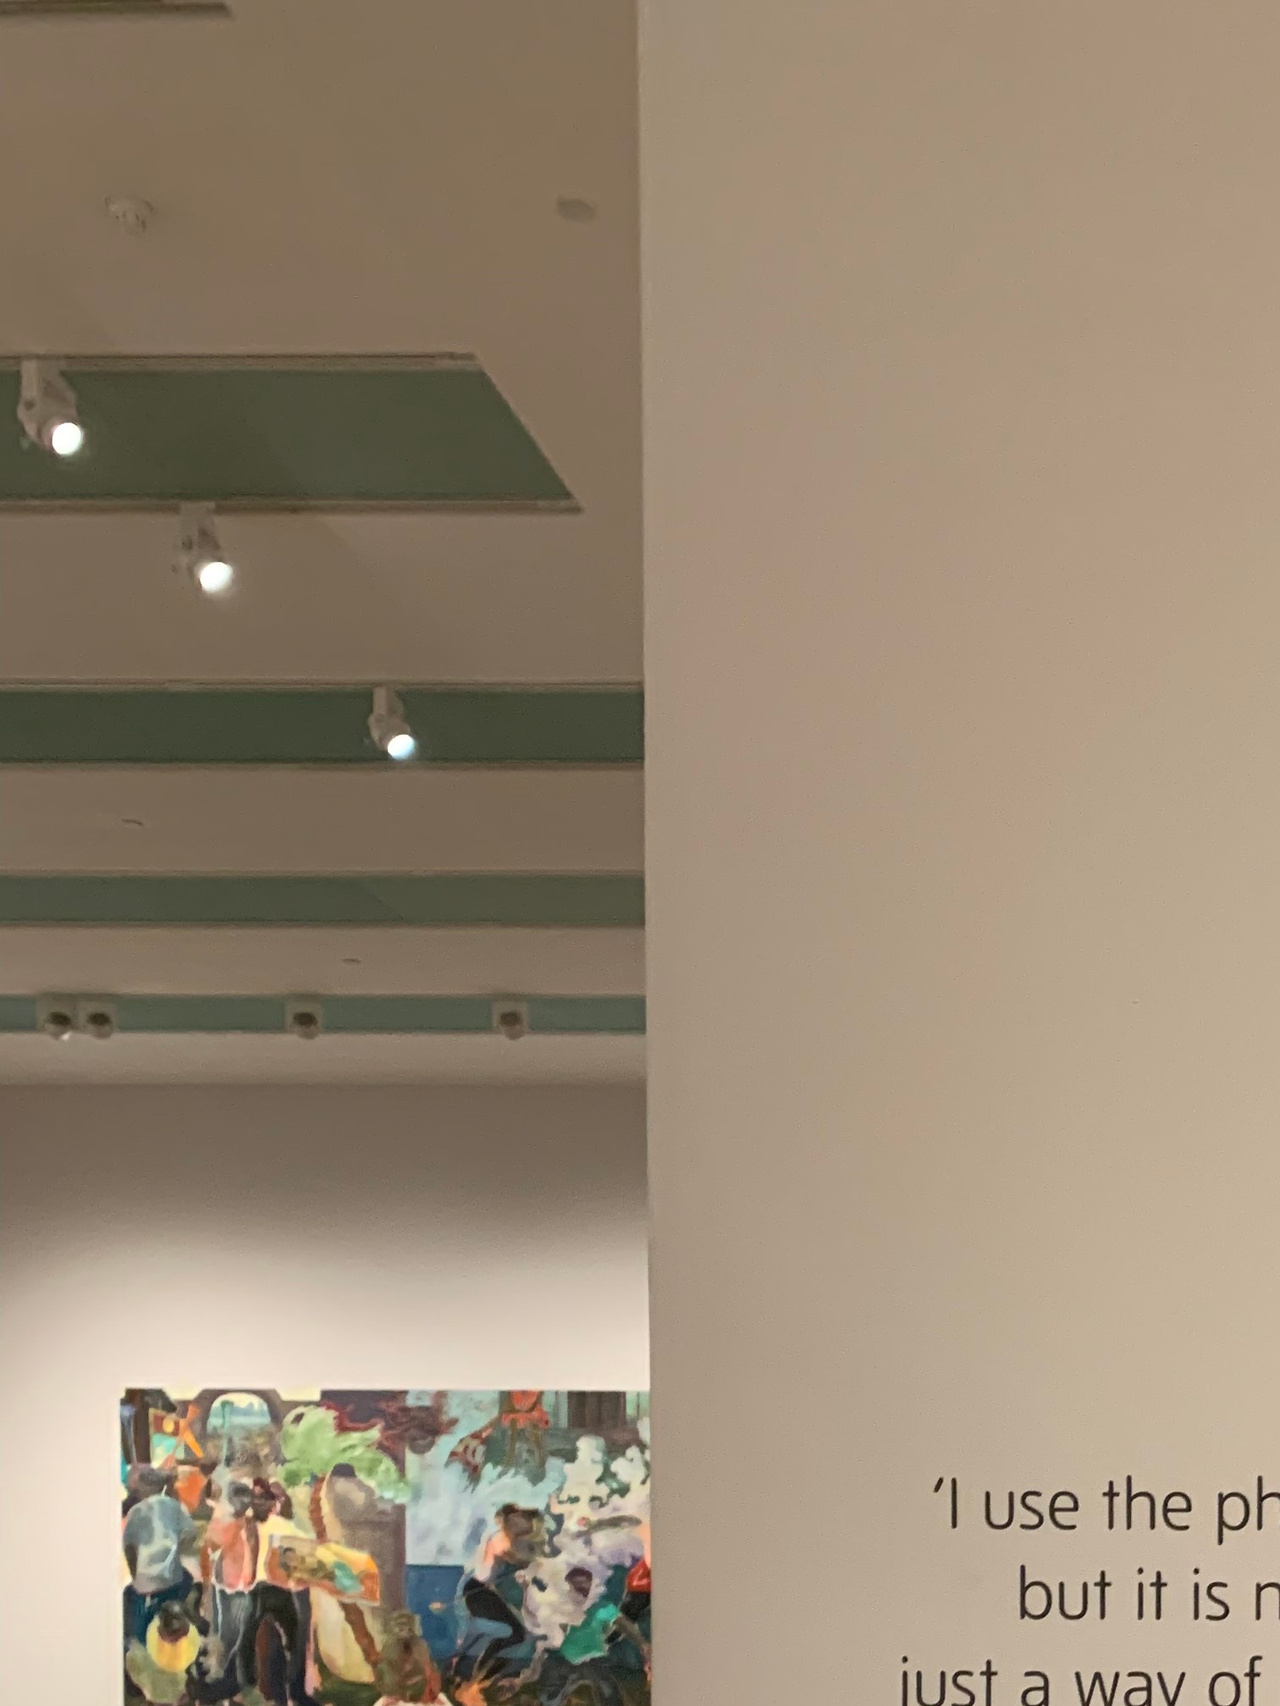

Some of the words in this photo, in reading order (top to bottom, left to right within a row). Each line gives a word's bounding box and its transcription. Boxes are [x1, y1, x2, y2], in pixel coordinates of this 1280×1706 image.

[984, 1489, 1080, 1531] use
[1101, 1474, 1193, 1532] the
[1019, 1563, 1113, 1621] but
[1136, 1566, 1169, 1621] it
[1192, 1567, 1231, 1622] is
